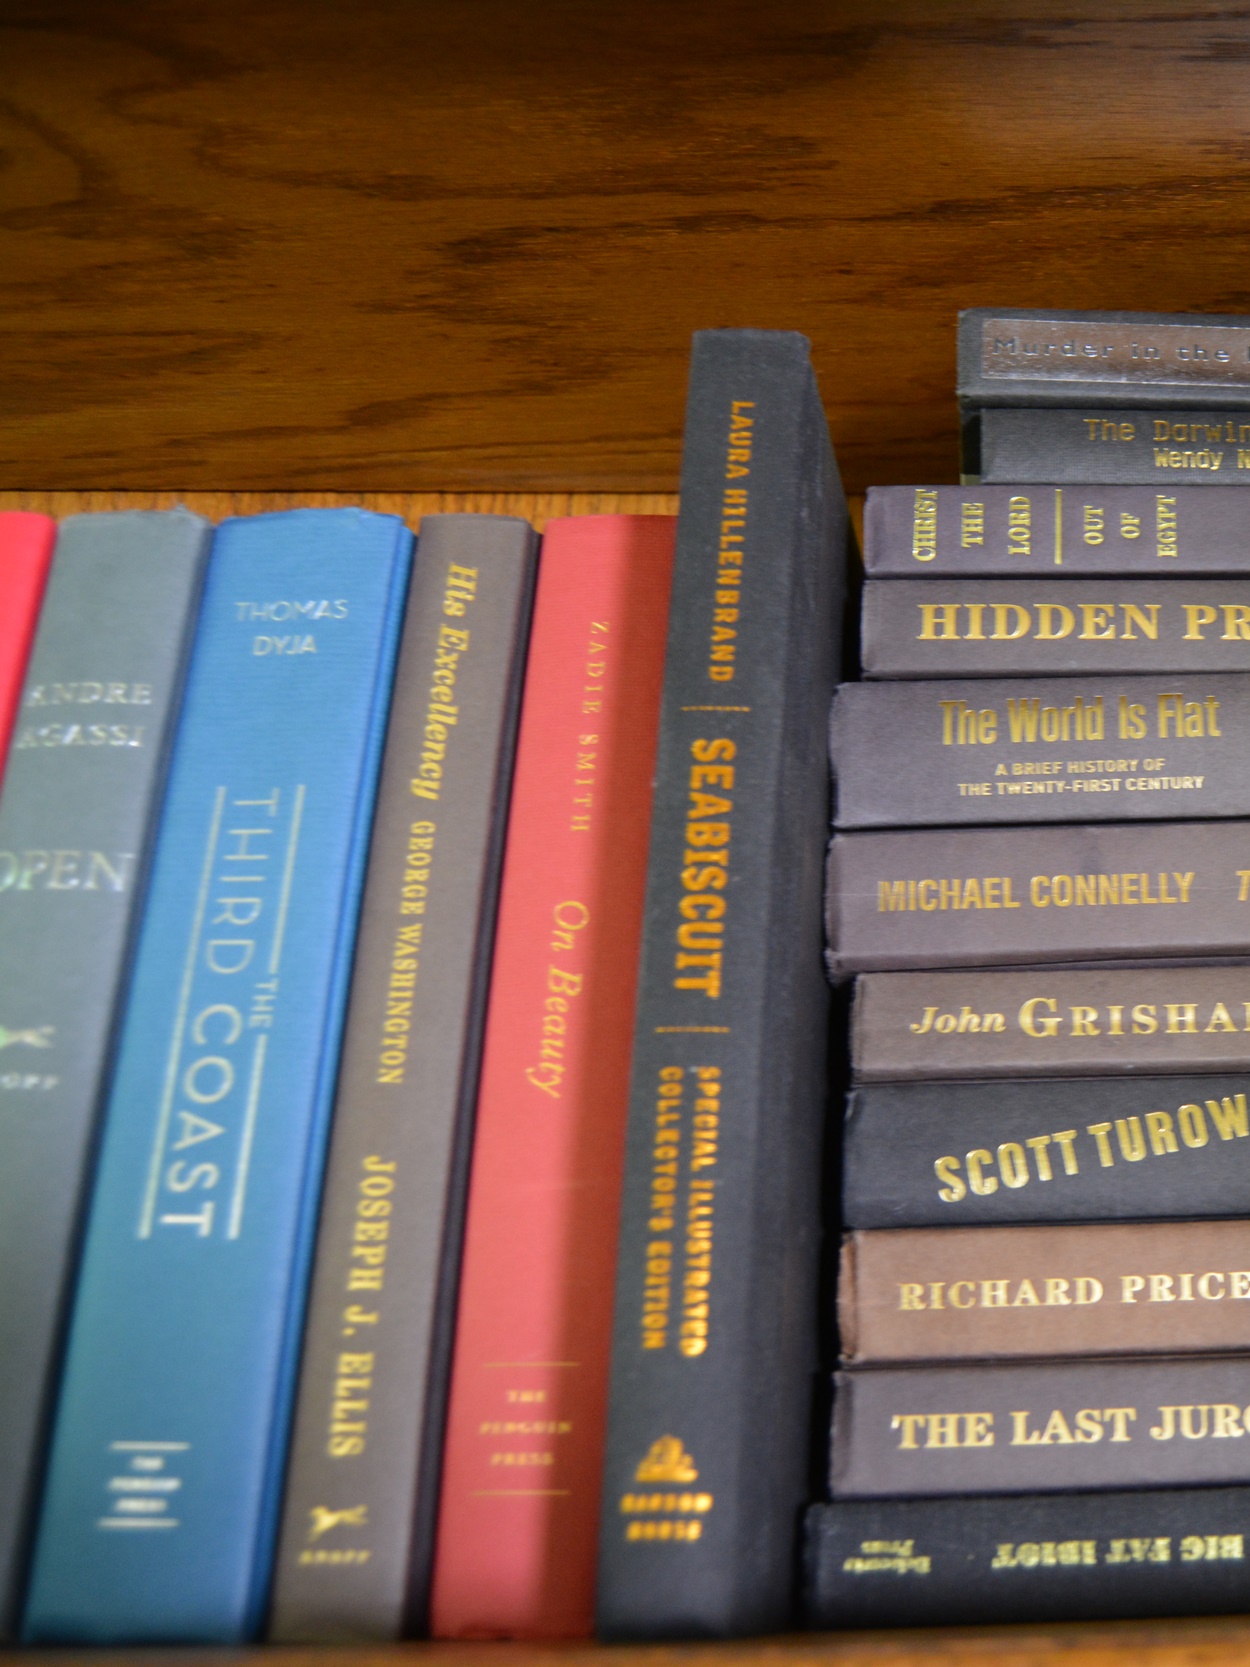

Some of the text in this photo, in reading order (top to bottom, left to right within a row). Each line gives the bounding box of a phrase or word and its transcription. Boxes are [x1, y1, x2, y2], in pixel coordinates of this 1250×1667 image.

[993, 337, 1114, 358] Murder
[1132, 342, 1160, 361] in
[1176, 344, 1230, 363] the
[1083, 418, 1136, 442] The
[1153, 448, 1224, 472] Wendy
[708, 399, 757, 683] LAURA HILLENBRAND
[912, 489, 938, 562] CHRIST
[960, 502, 985, 548] THE
[1007, 496, 1031, 555] LORD
[1083, 505, 1104, 545] OUT
[1120, 512, 1141, 539] OF
[1156, 495, 1178, 557] EGYPT
[234, 598, 349, 622] THOMAS
[916, 603, 1162, 641] HIDDEN
[252, 634, 317, 656] DYJA
[26, 681, 152, 707] ANDRE
[409, 562, 479, 801] His Excellency
[16, 724, 145, 748] AGASSI
[570, 620, 610, 832] ZADIE SMITH
[938, 693, 1222, 745] The World Is Flat
[958, 775, 1205, 797] THE TWENTY-FIRST CENTURY
[994, 757, 1166, 777] A BRIEF HISTORY OF
[205, 787, 281, 975] THIRD
[673, 737, 736, 999] SEABISCUIT
[876, 878, 1021, 912] MICHAEL
[1029, 871, 1195, 907] CONNELLY
[377, 820, 436, 1085] GEORGE WASHINGTON
[249, 978, 280, 1029] THE
[524, 899, 591, 1099] On Beauty
[910, 1006, 1006, 1034] John
[160, 1003, 243, 1237] COAST
[933, 1093, 1250, 1203] SCOTT TUROW
[641, 1065, 684, 1350] COLLECTOR'S EDITION
[679, 1065, 722, 1358] SPECIAL ILLUSTRATED
[327, 1155, 397, 1459] JOSEPH J. ELLIS
[897, 1276, 1103, 1311] RICHARD
[891, 1412, 995, 1449] THE
[1009, 1407, 1137, 1446] LAST
[991, 1539, 1097, 1570] IDIOT
[1105, 1537, 1171, 1564] FAT
[1180, 1534, 1245, 1561] BIG
